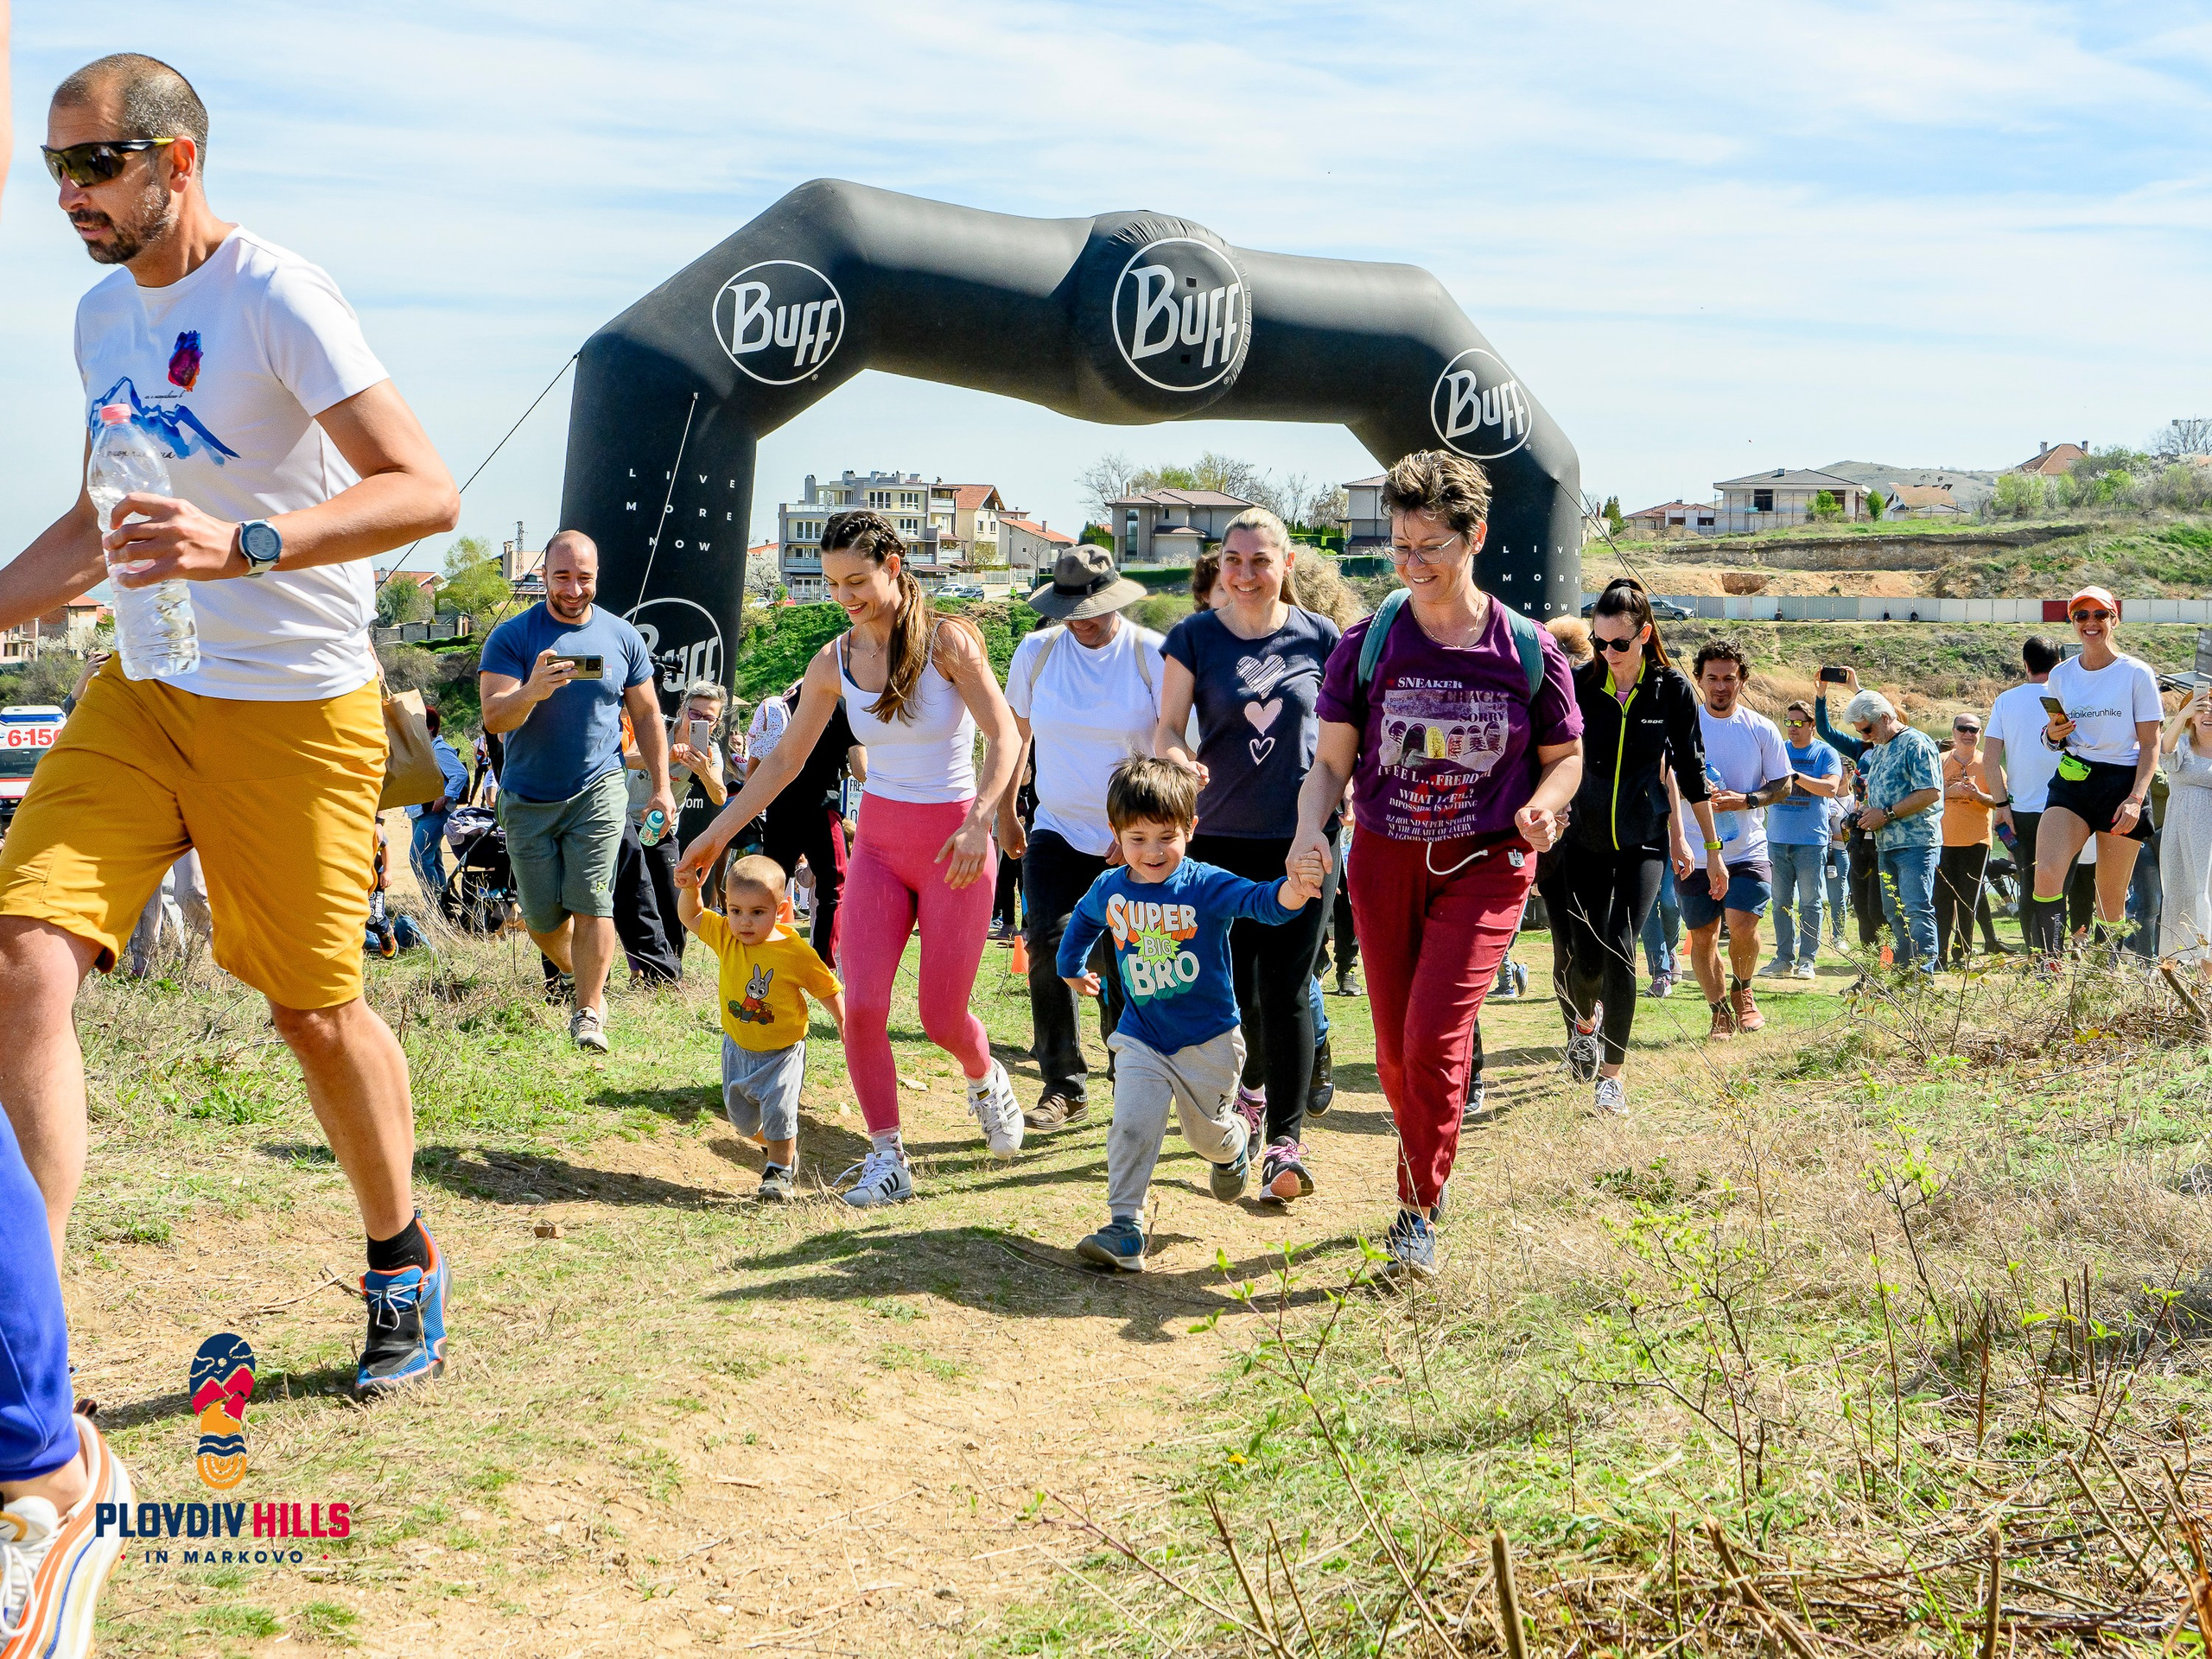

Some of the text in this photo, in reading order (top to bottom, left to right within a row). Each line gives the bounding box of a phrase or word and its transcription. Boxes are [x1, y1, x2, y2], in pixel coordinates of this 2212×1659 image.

[1523, 602, 1568, 612] NOW
[1398, 677, 1463, 689] SNEAKER
[1459, 712, 1505, 723] SORRY
[2066, 708, 2122, 719] dibikerunhike
[1400, 788, 1433, 804] WHAT
[1107, 893, 1198, 944] SUPER
[1143, 935, 1172, 957] BIG
[1125, 951, 1200, 999] BRO
